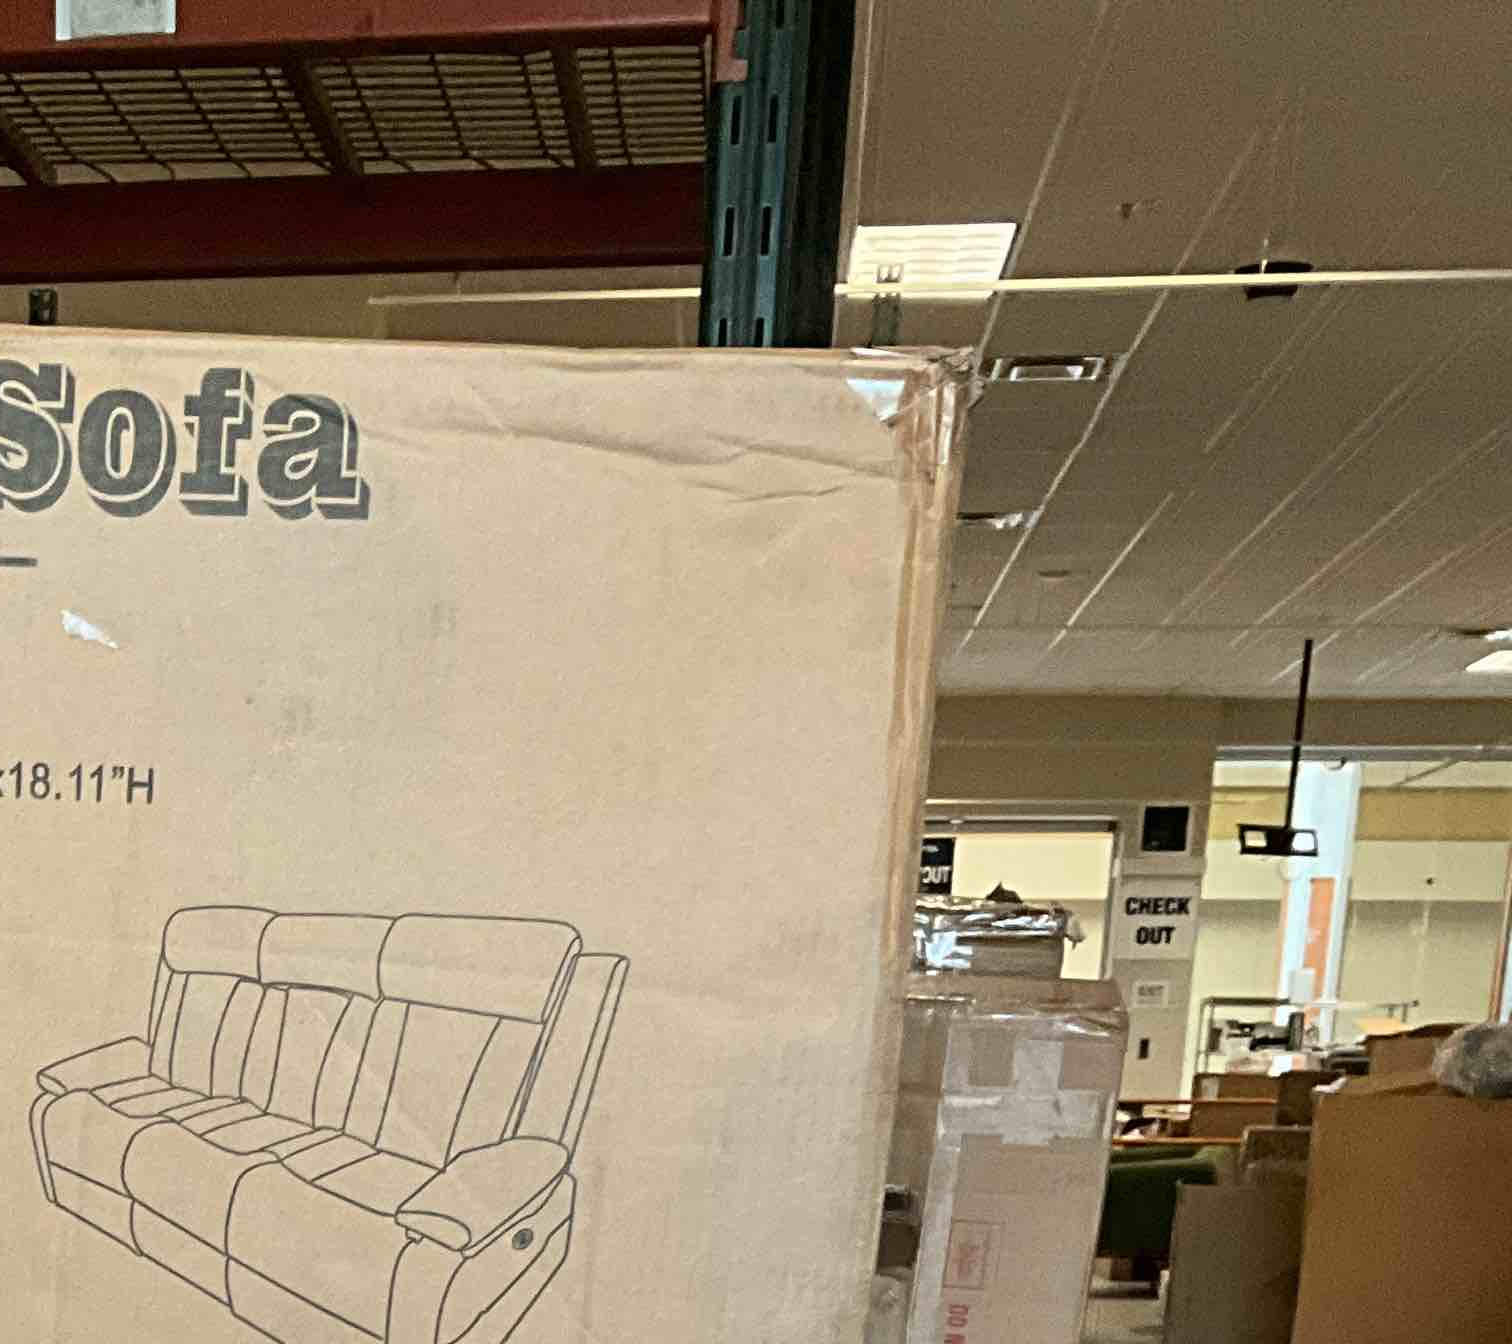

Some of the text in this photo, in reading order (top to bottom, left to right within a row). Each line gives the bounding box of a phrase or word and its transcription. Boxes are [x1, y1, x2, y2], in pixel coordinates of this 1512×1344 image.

[1125, 896, 1191, 917] CHECK
[1135, 926, 1177, 946] OUT
[949, 1303, 970, 1329] DO
